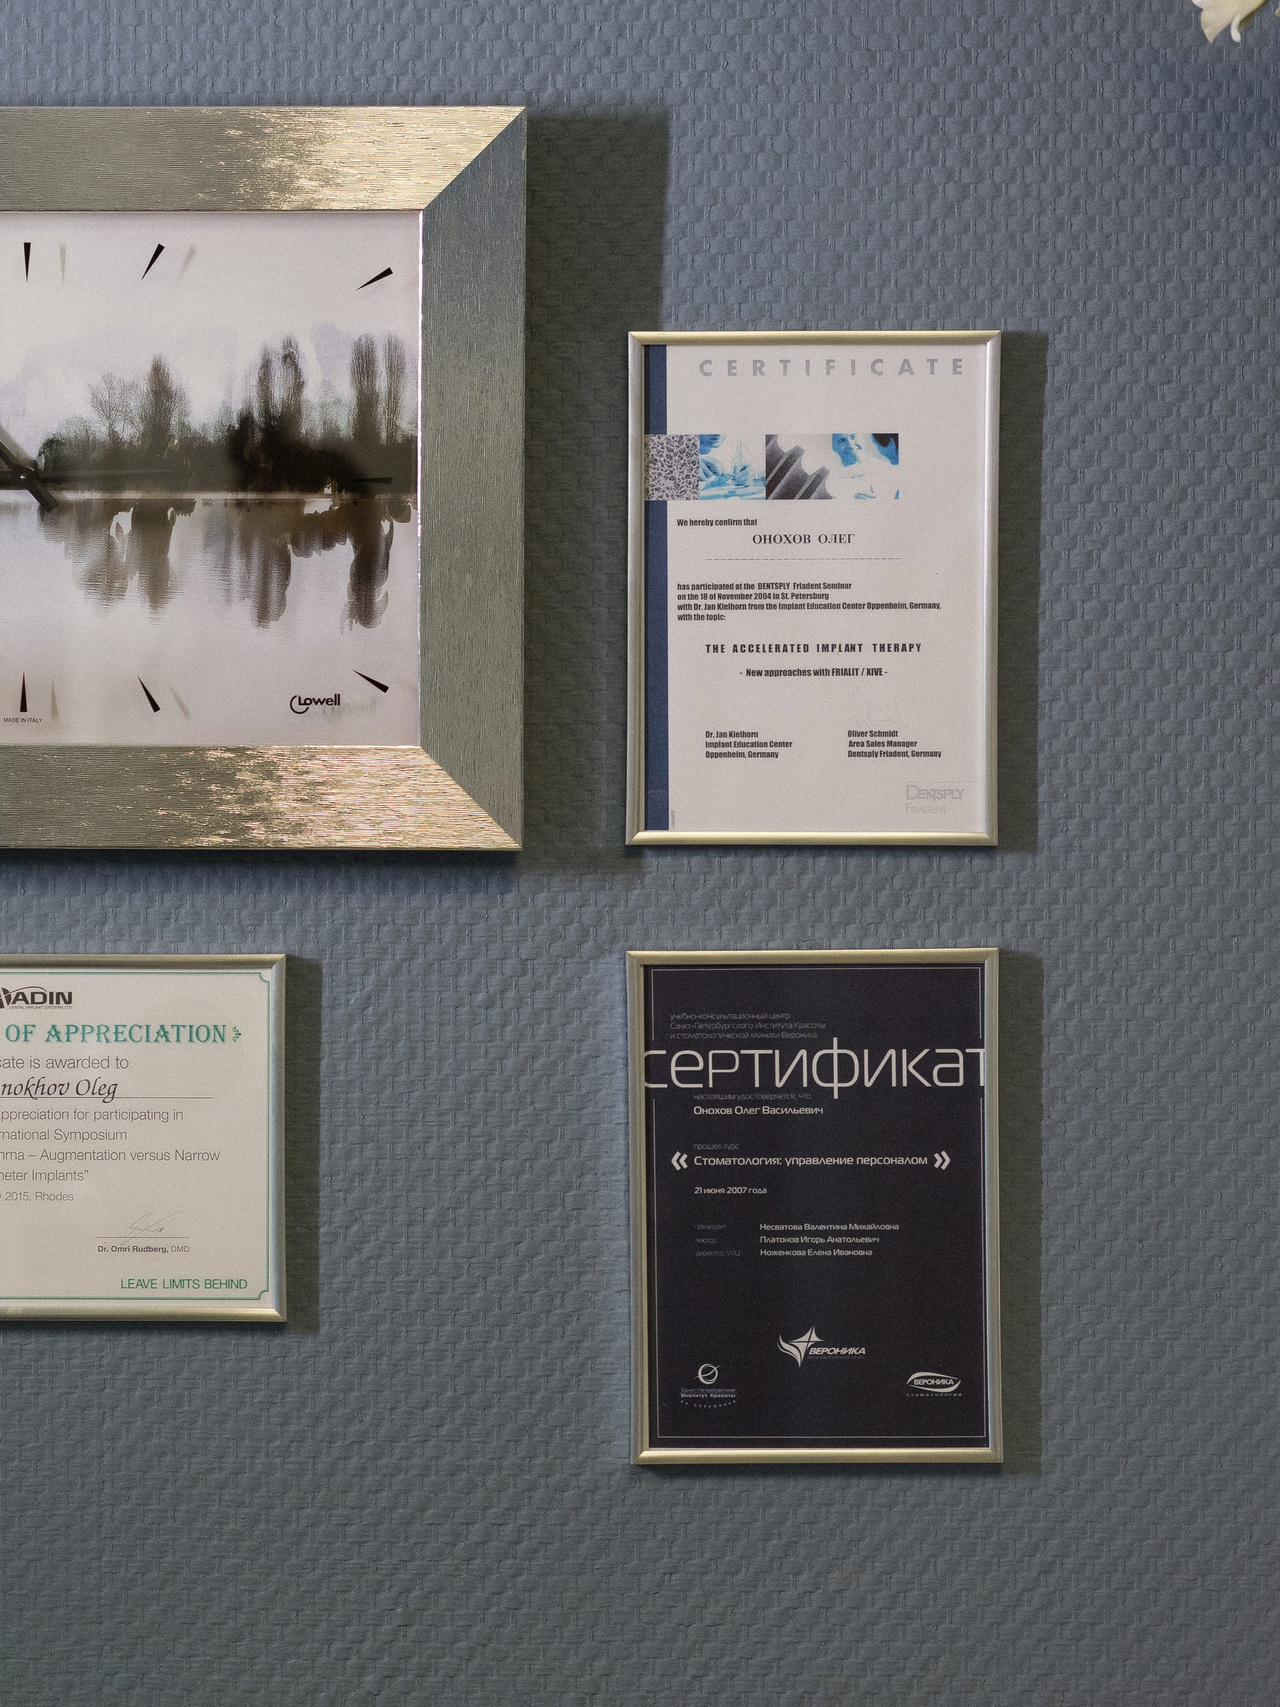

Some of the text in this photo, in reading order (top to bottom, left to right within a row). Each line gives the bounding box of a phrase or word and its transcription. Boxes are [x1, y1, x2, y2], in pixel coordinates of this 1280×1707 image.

[699, 358, 964, 377] CERTIFICATE
[676, 517, 758, 527] We hereby confirm that
[752, 533, 856, 545] ОНОХОВ ОЛЕГ
[677, 581, 853, 591] has participated at the DENTSPLY Friadent Seminar
[705, 643, 922, 654] THE ACCELERATED IMPLANT THERAPY
[848, 739, 918, 750] Area Sales Manager
[6, 1024, 36, 1042] OF
[45, 1024, 226, 1043] APPRECIATION
[29, 1055, 41, 1070] is
[45, 1055, 110, 1070] awarded
[114, 1055, 130, 1070] to
[75, 1076, 118, 1104] Oleg
[73, 1108, 90, 1121] for
[94, 1109, 168, 1123] participating
[173, 1108, 184, 1121] in
[693, 1105, 824, 1115] Онохов Олег Васильевич
[53, 1128, 128, 1143] Symposium
[40, 1149, 126, 1163] Augmentation
[129, 1151, 171, 1162] versus
[174, 1149, 221, 1162] Narrow
[693, 1156, 783, 1166] Стоматология:
[784, 1157, 855, 1167] управление
[856, 1156, 928, 1167] персоналом
[693, 1186, 703, 1195] 21
[703, 1187, 726, 1195] июня
[726, 1186, 748, 1195] 2007
[4, 1191, 32, 1202] 2015,
[34, 1191, 75, 1202] Rhodes
[759, 1223, 900, 1231] Несватова Валентина Михайловна
[759, 1235, 880, 1245] Платонов Игорь Анатольевич
[97, 1243, 191, 1255] Dr. Omri Rudberg, DMD
[759, 1248, 873, 1257] Ноженкова Елена Ивановна
[120, 1278, 248, 1290] LEAVE LIMITS BEHIND
[808, 1347, 866, 1355] ВЕРОНИКА
[913, 1378, 954, 1386] ВЕРОНИКА
